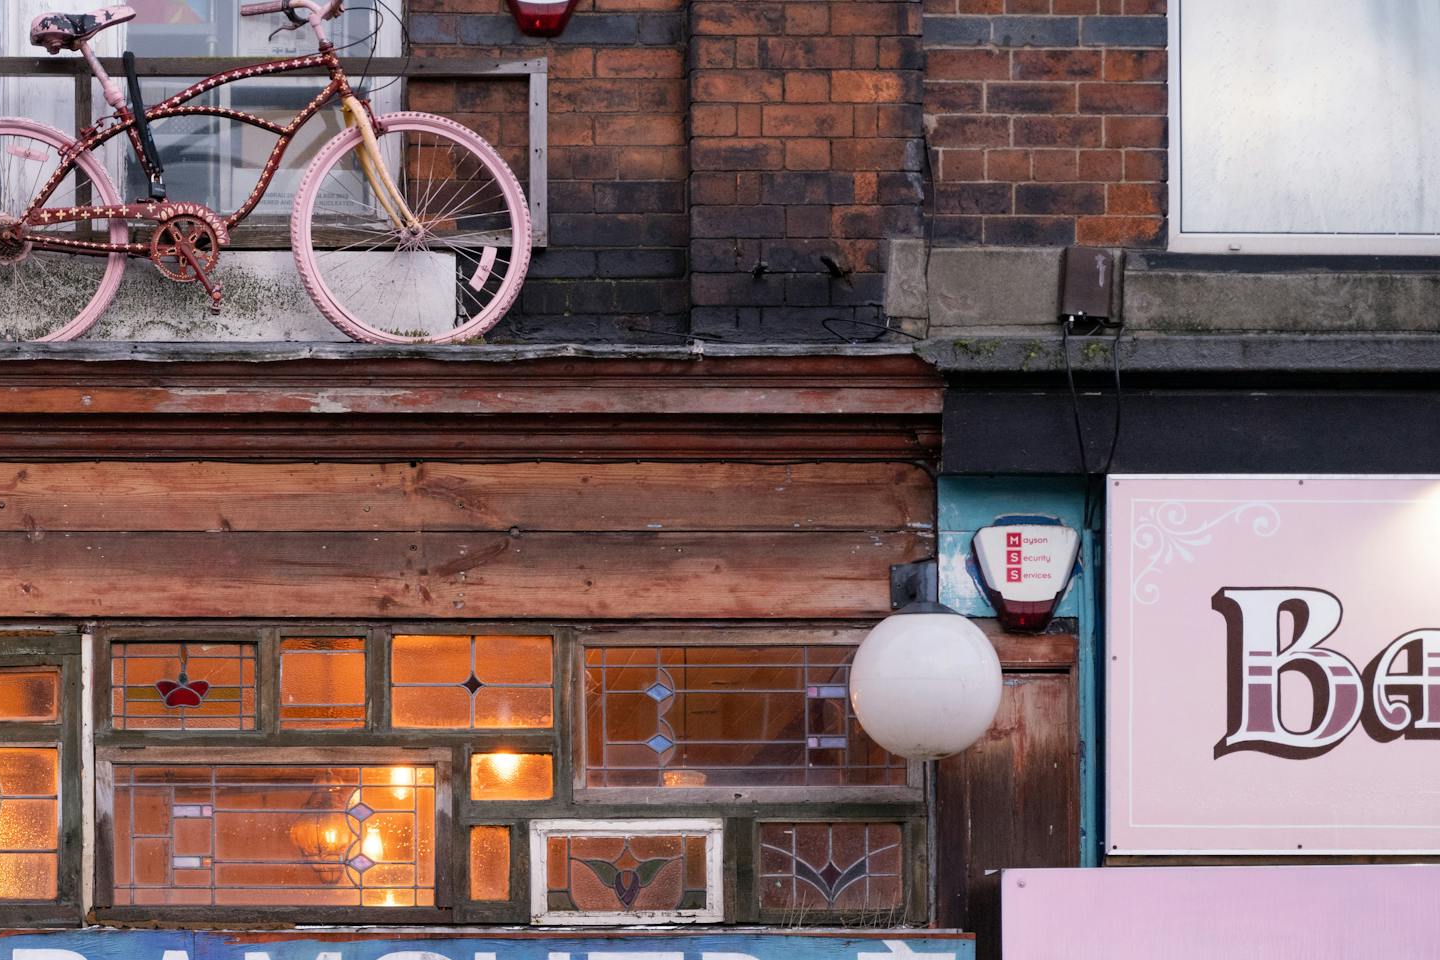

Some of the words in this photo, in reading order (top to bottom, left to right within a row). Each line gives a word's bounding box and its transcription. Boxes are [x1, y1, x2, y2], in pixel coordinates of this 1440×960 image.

[1008, 534, 1048, 546] Mayson
[1008, 551, 1051, 564] Security
[1008, 569, 1052, 581] Services
